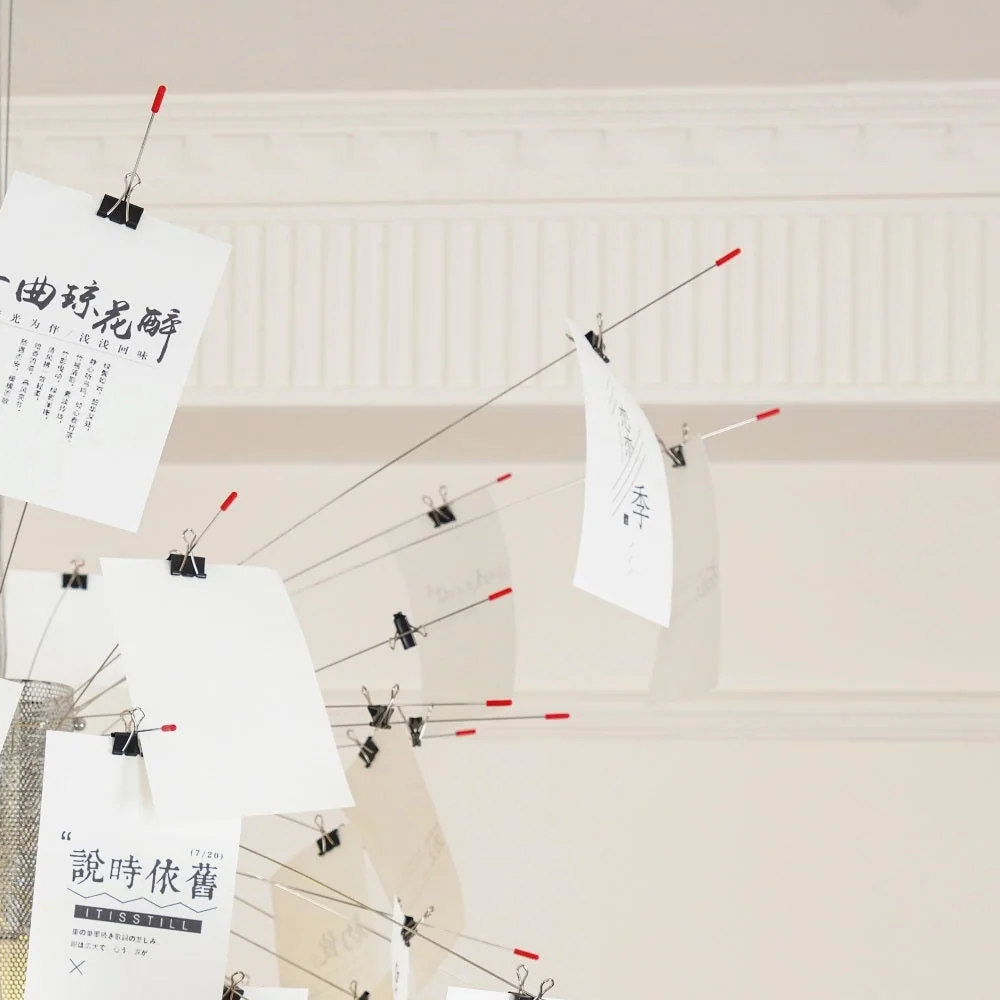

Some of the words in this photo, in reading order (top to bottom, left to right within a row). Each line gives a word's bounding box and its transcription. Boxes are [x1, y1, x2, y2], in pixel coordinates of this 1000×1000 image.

[631, 485, 650, 529] 季
[190, 849, 225, 860] (7/20)
[69, 848, 219, 901] 說時依舊
[84, 906, 190, 932] ITISSTILL
